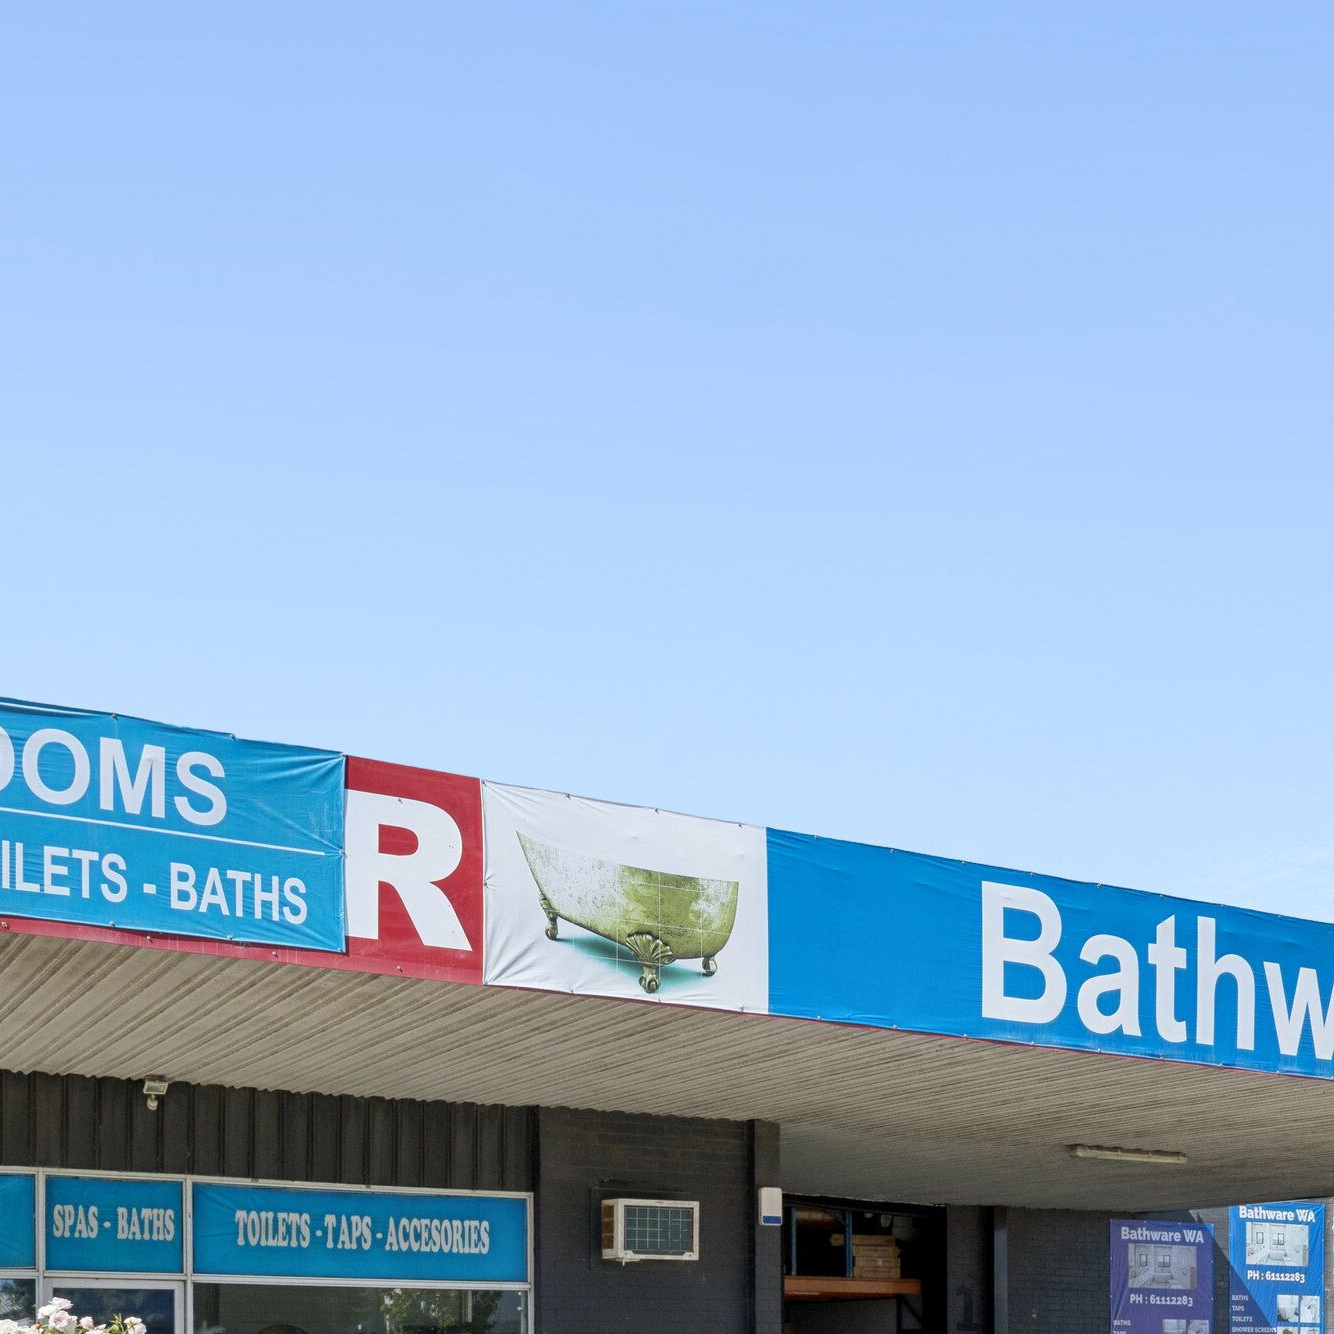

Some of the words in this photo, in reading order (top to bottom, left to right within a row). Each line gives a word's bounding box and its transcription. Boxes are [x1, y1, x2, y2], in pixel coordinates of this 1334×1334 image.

[345, 788, 473, 951] R
[170, 862, 308, 925] BATHS
[53, 1204, 99, 1239] SPAS
[117, 1207, 175, 1241] BATHS
[1239, 1205, 1295, 1221] Bathware
[1296, 1209, 1316, 1223] WA
[235, 1209, 312, 1249] TOILETS
[324, 1214, 372, 1251] TAPS
[385, 1218, 490, 1255] ACCESORIES
[1121, 1226, 1182, 1242] Bathware
[1183, 1229, 1205, 1244] WA
[1247, 1270, 1260, 1280] PH
[1265, 1271, 1306, 1284] 61112283
[1130, 1294, 1143, 1304] PH
[1150, 1295, 1194, 1307] 61112283
